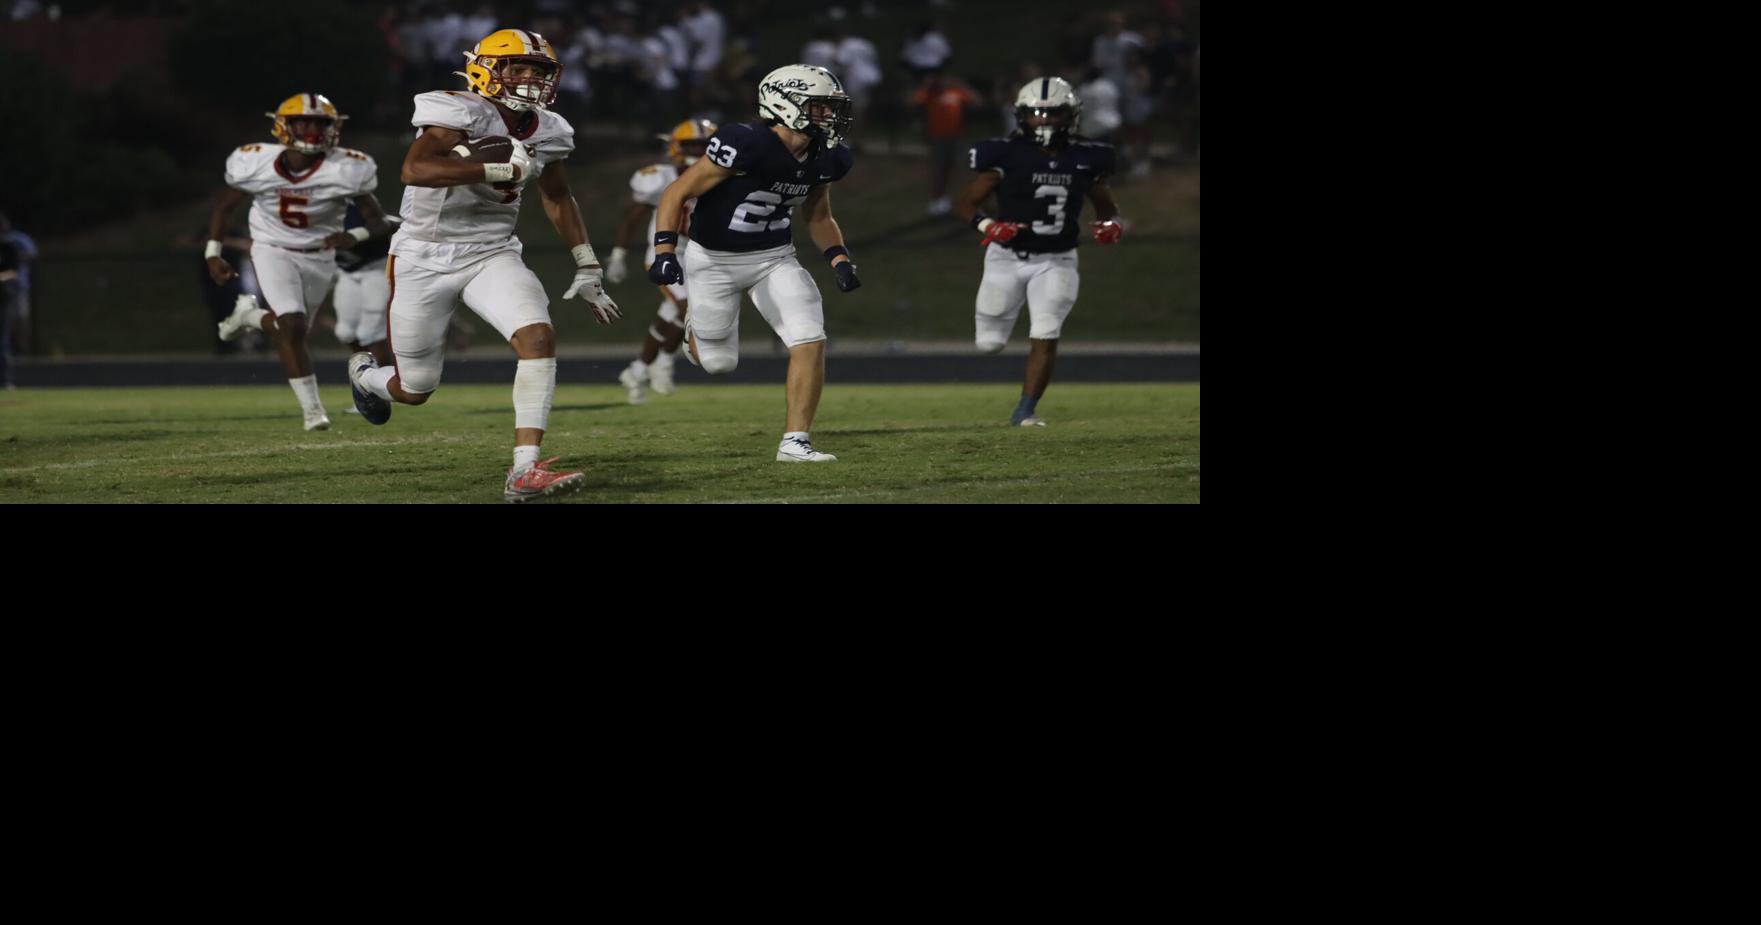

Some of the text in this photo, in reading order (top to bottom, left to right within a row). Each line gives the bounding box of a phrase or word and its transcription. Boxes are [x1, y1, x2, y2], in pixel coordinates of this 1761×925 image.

[705, 136, 738, 168] 23
[967, 147, 978, 168] 3
[769, 181, 811, 196] PATRIOTS
[1032, 172, 1073, 185] PATRIOTS
[279, 194, 309, 230] 5
[1031, 184, 1069, 236] 3
